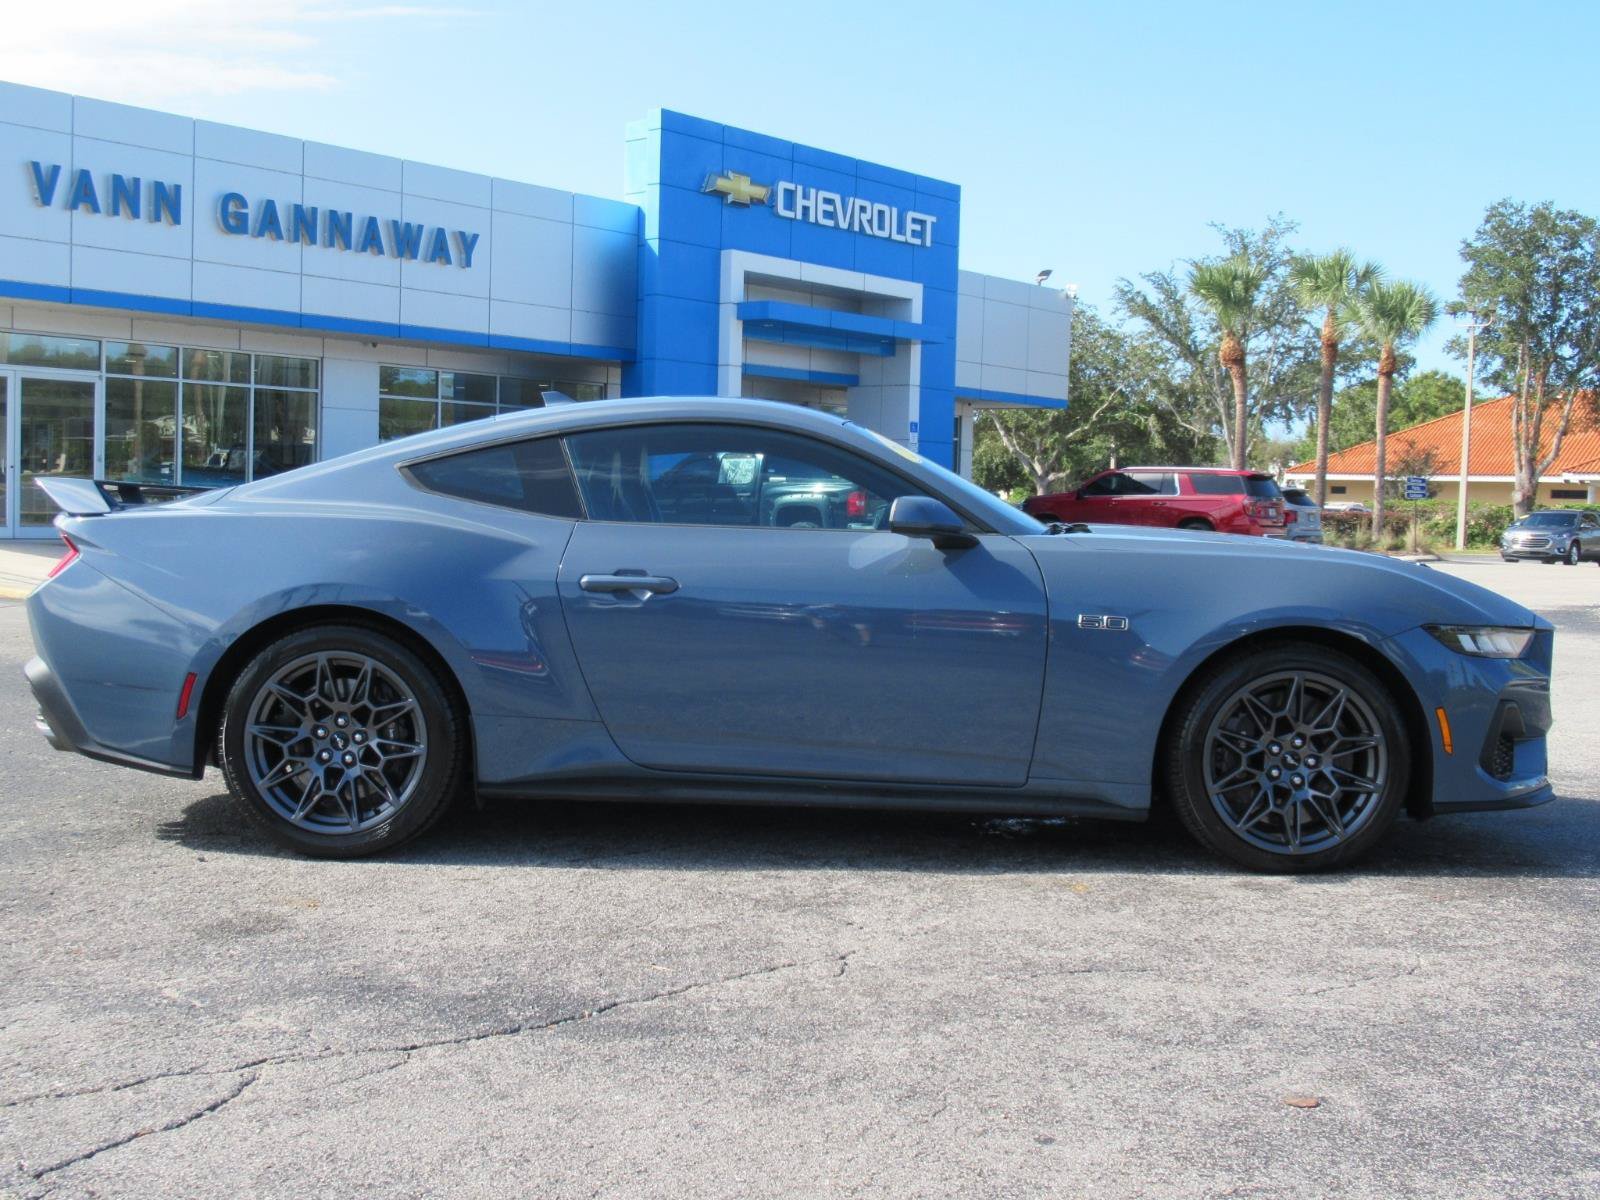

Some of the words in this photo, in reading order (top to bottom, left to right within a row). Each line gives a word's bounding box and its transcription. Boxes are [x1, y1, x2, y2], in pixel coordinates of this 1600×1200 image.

[30, 161, 182, 226] VANN
[219, 192, 480, 269] GANNAWAY
[776, 180, 937, 248] CHEVROLET
